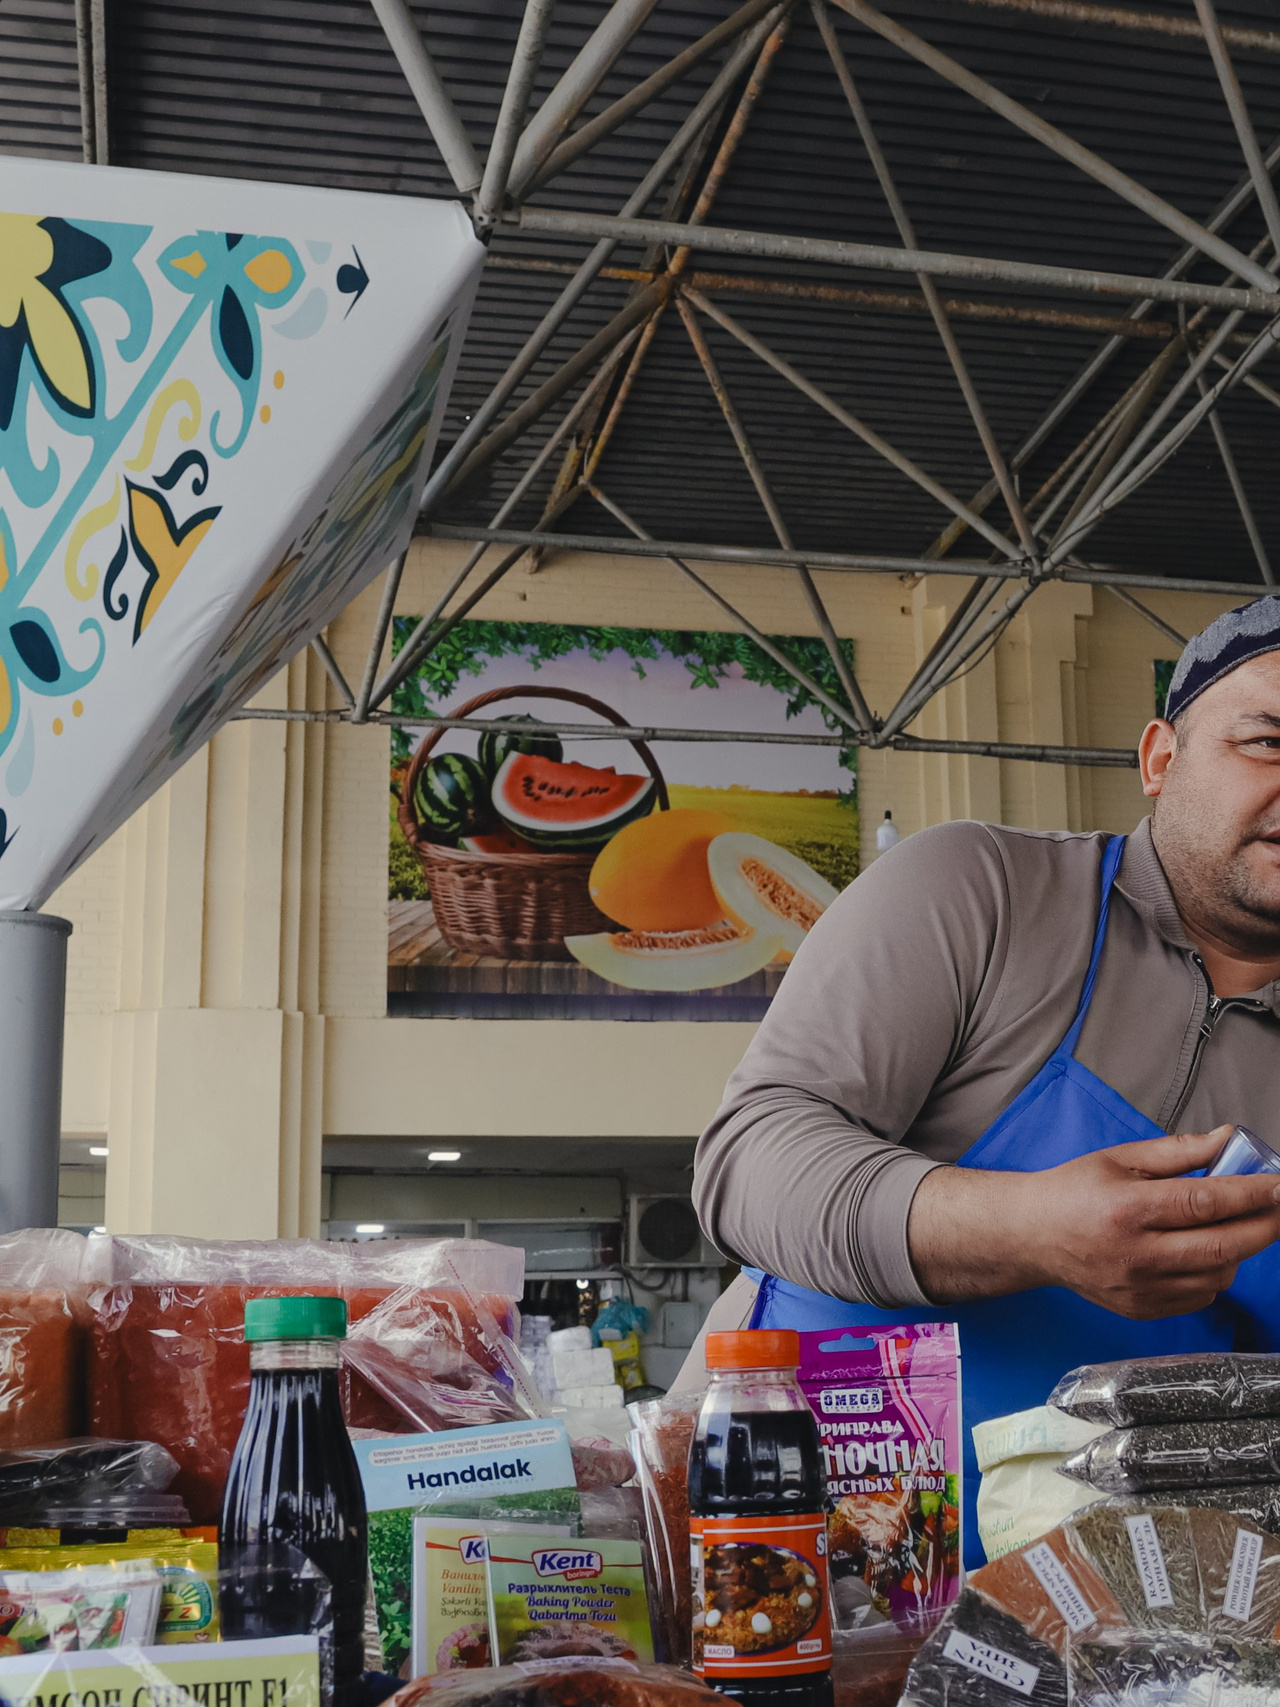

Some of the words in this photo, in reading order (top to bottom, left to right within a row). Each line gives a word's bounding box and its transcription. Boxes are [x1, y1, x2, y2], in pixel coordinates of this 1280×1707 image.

[823, 1393, 880, 1406] OMEGA
[818, 1420, 905, 1437] РИПРАВА
[823, 1438, 946, 1476] НОЧНАЯ
[407, 1459, 532, 1490] Handalak
[827, 1477, 895, 1494] ЯСНЫХ
[901, 1476, 946, 1492] БЛЮД
[539, 1552, 595, 1571] Kent
[1235, 1536, 1249, 1579] CORIANDER
[442, 1582, 482, 1594] Vanilin
[508, 1583, 598, 1596] Разрыхлитель
[600, 1583, 631, 1597] Теста
[1230, 1580, 1241, 1610] POWDER
[526, 1596, 570, 1610] Baking
[572, 1596, 615, 1608] Powder
[589, 1610, 617, 1621] Tozu
[970, 1641, 1020, 1671] ЗИРА
[954, 1649, 1025, 1687] CUMIN
